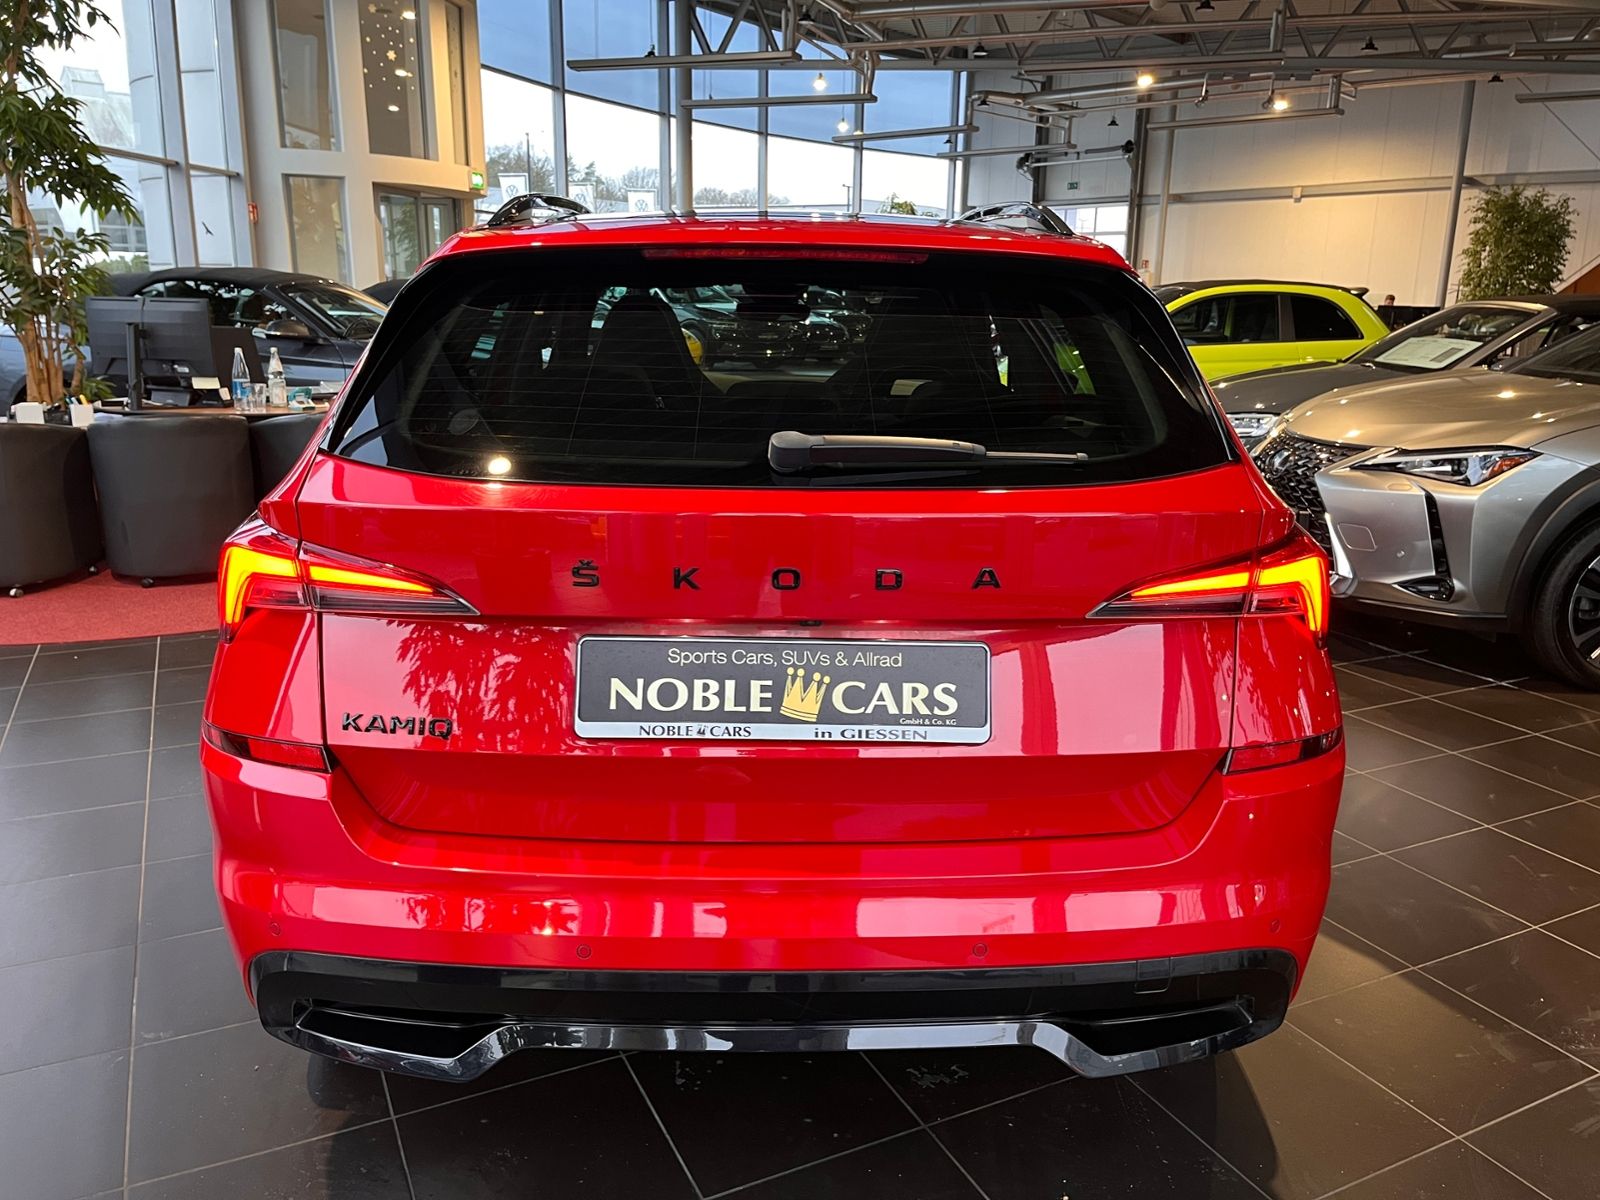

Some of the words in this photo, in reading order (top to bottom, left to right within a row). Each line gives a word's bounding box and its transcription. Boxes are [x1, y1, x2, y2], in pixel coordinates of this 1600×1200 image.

[668, 648, 727, 666] Sports
[731, 649, 777, 667] Cars,
[782, 650, 830, 666] SUVs
[835, 651, 848, 666] &
[853, 652, 902, 667] Allrad
[609, 677, 773, 712] NOBLE
[831, 681, 959, 716] CARS
[342, 712, 453, 740] KAMIQ
[900, 717, 923, 725] GmbH
[639, 725, 693, 736] NOBLE
[710, 726, 752, 737] CARS
[814, 728, 832, 738] in
[840, 728, 928, 740] GIESSEN
